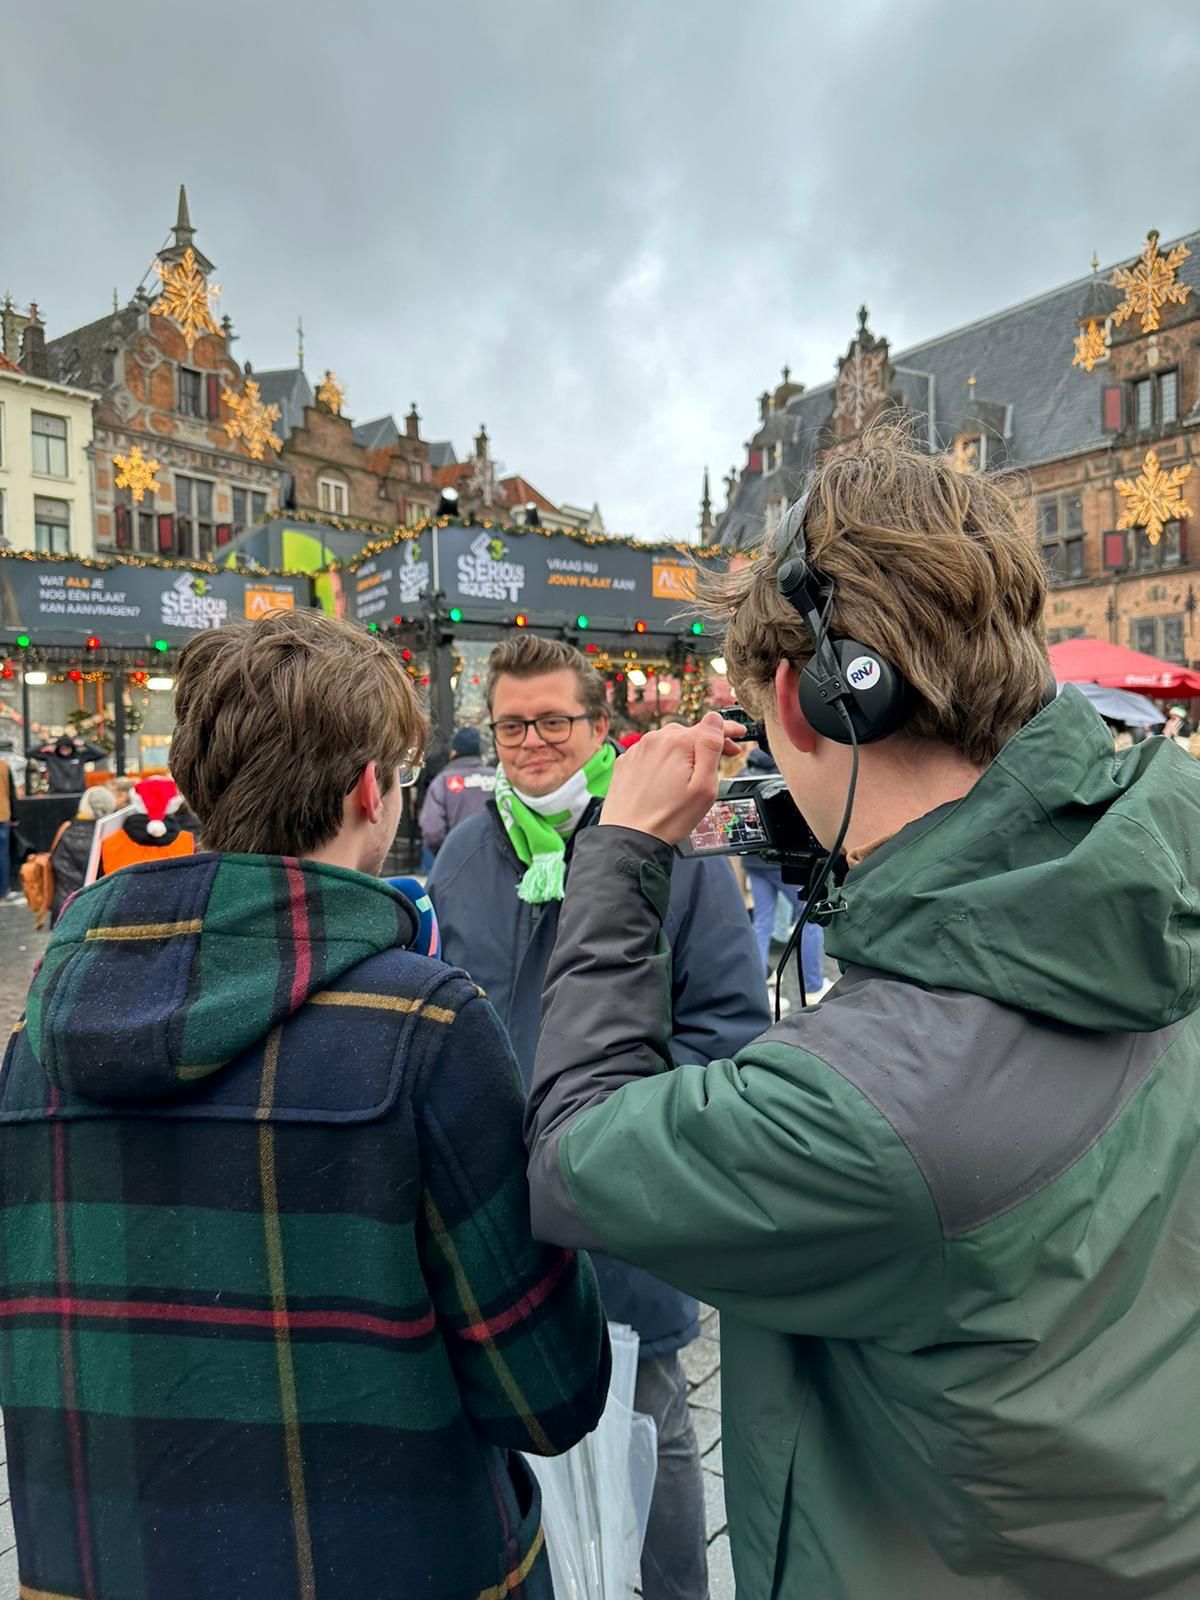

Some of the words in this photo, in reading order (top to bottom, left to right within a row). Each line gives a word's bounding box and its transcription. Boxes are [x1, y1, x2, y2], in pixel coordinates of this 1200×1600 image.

[457, 554, 525, 583] SERIOUS
[546, 558, 582, 573] VRAAG
[583, 560, 599, 574] NU
[39, 575, 65, 586] WAT
[66, 576, 90, 588] ALS
[91, 577, 104, 589] JE
[547, 573, 578, 585] JOUW
[579, 575, 612, 589] PLAAT
[39, 588, 67, 600] NOG
[67, 590, 90, 601] EEN
[91, 591, 126, 603] PLAAT
[39, 602, 66, 614] KAN
[66, 604, 141, 617] AANVRAGEN?
